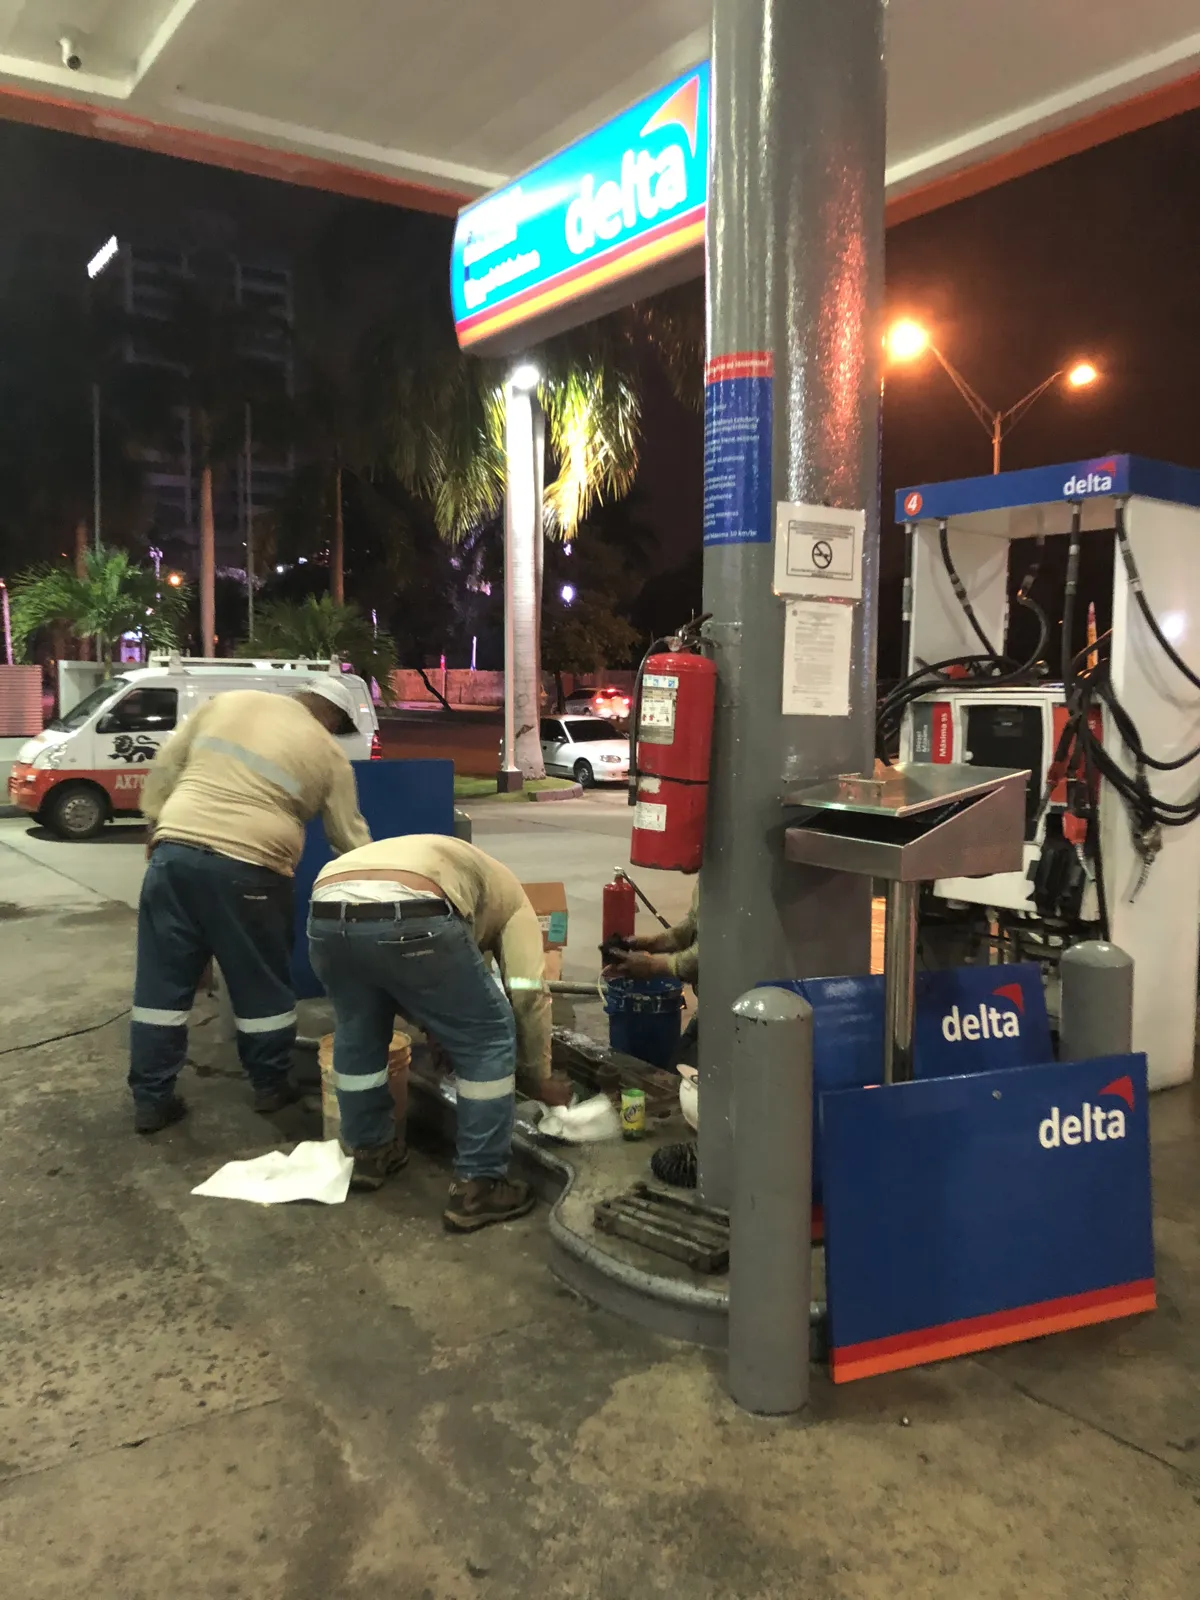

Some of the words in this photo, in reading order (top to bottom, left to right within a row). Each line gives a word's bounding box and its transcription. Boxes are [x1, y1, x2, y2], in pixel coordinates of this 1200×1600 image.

[565, 145, 687, 254] delta
[1063, 473, 1112, 496] delta
[908, 495, 917, 511] 4
[941, 713, 948, 722] 95
[939, 724, 947, 756] Máxima
[941, 1003, 1020, 1043] delta
[1038, 1102, 1126, 1149] delta
